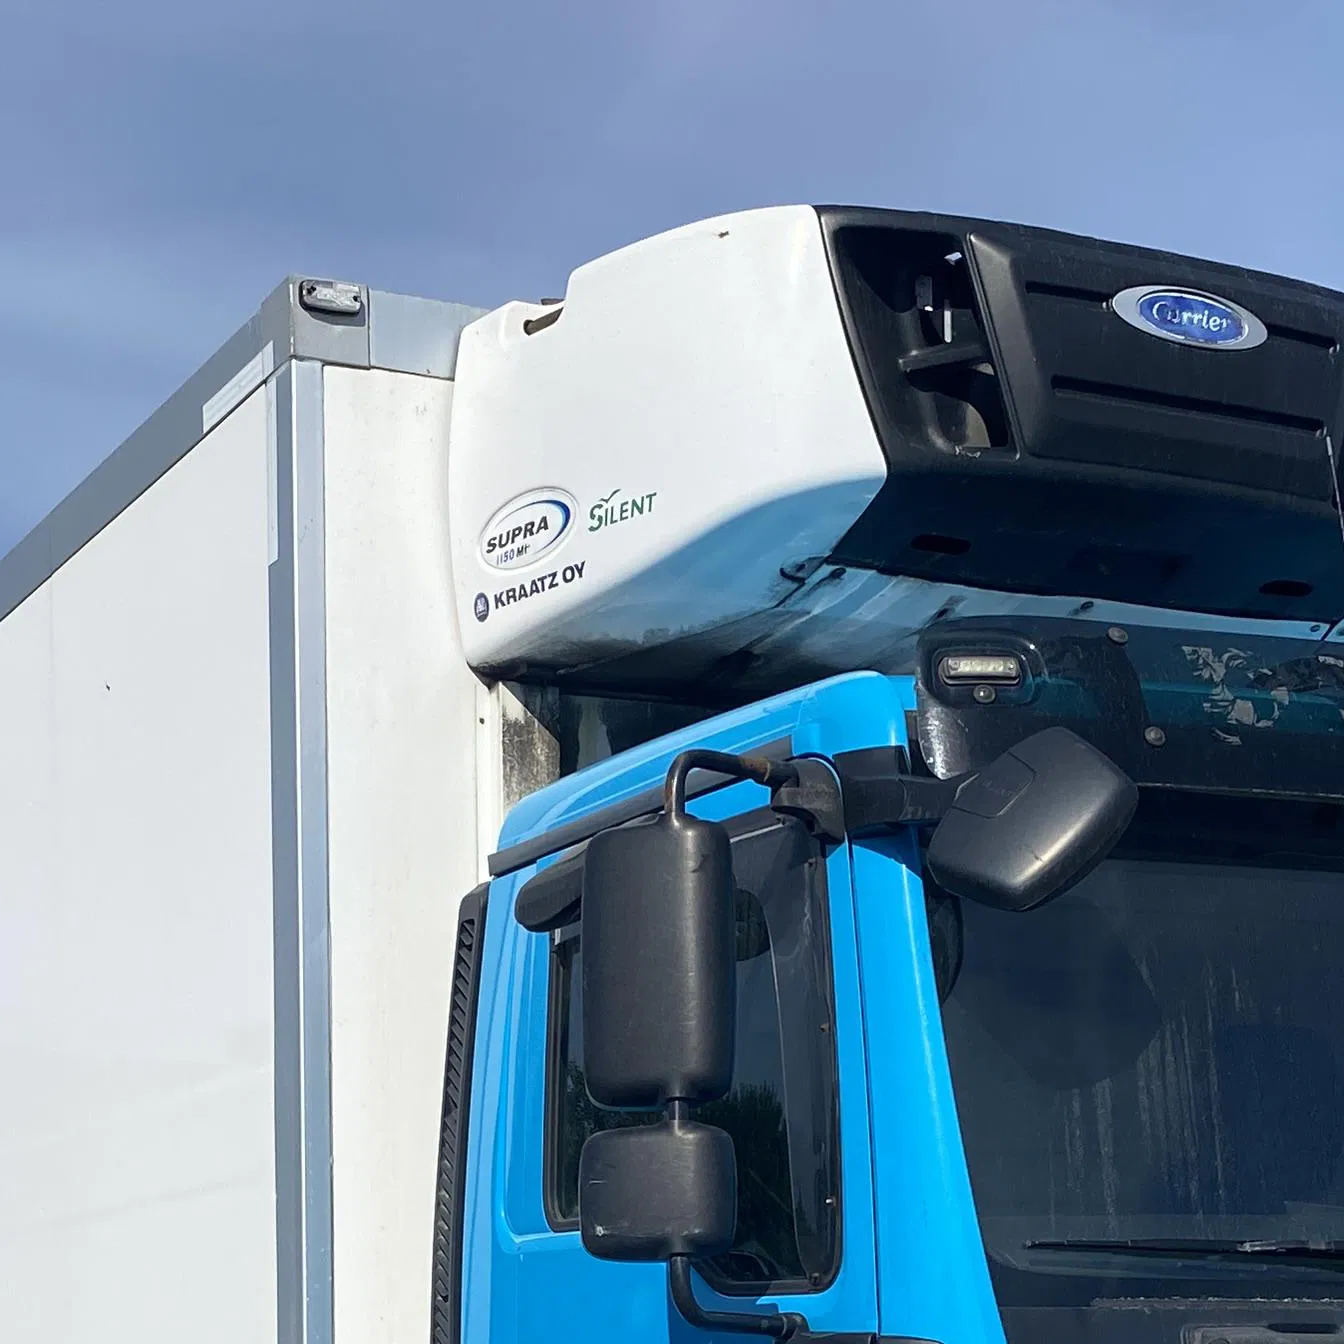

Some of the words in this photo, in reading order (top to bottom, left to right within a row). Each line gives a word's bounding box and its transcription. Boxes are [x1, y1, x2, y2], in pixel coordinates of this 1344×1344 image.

[588, 490, 657, 532] SILENT
[486, 515, 549, 554] SUPRA
[496, 548, 515, 566] 1150
[493, 570, 560, 609] KRAATZ
[561, 560, 586, 584] OY
